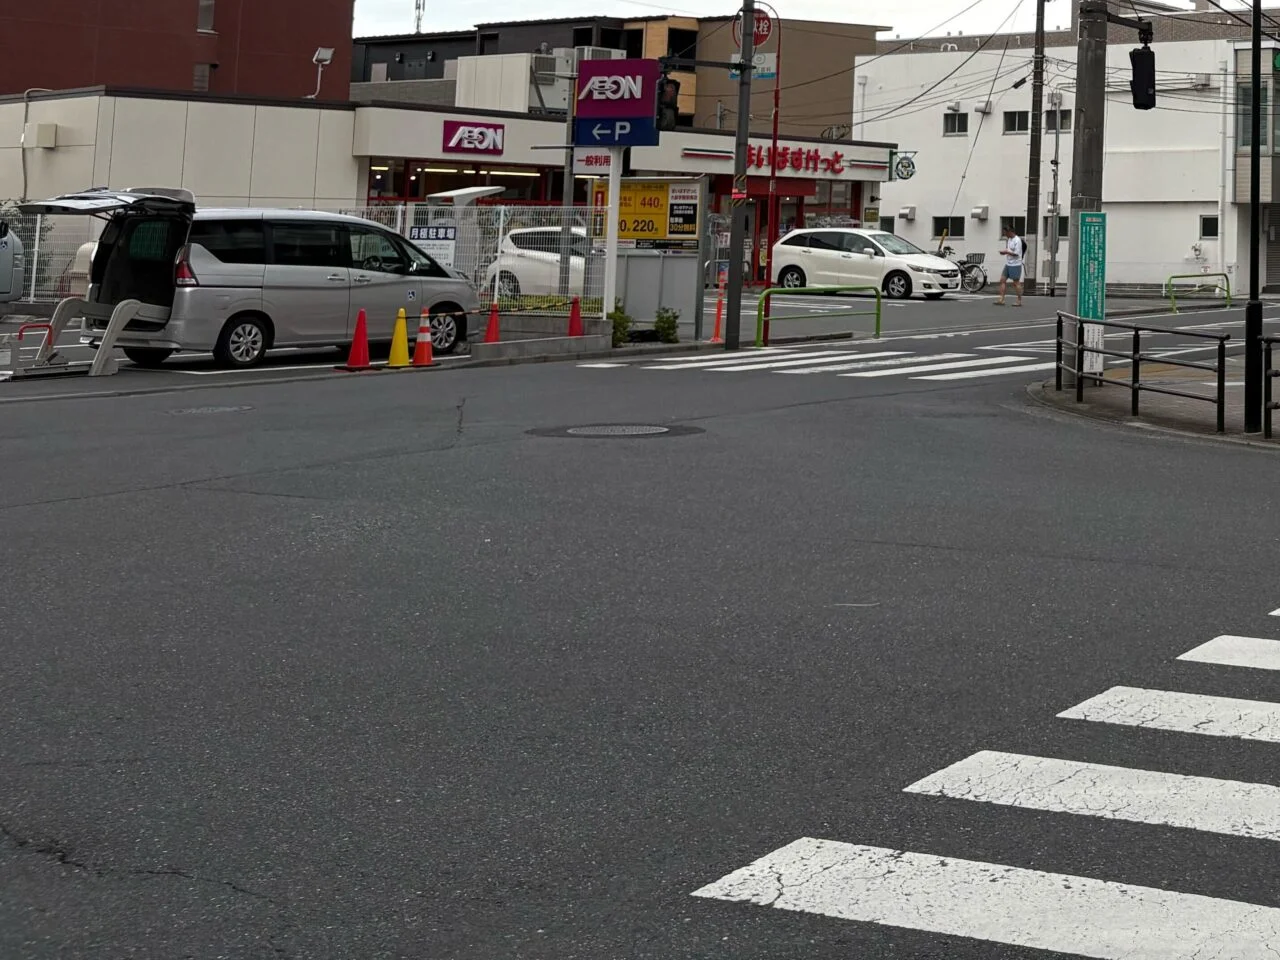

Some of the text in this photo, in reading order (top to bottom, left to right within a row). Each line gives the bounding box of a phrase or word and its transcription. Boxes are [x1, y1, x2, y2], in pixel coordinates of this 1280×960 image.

[614, 121, 631, 141] P
[411, 227, 456, 239] 月極駐車場
